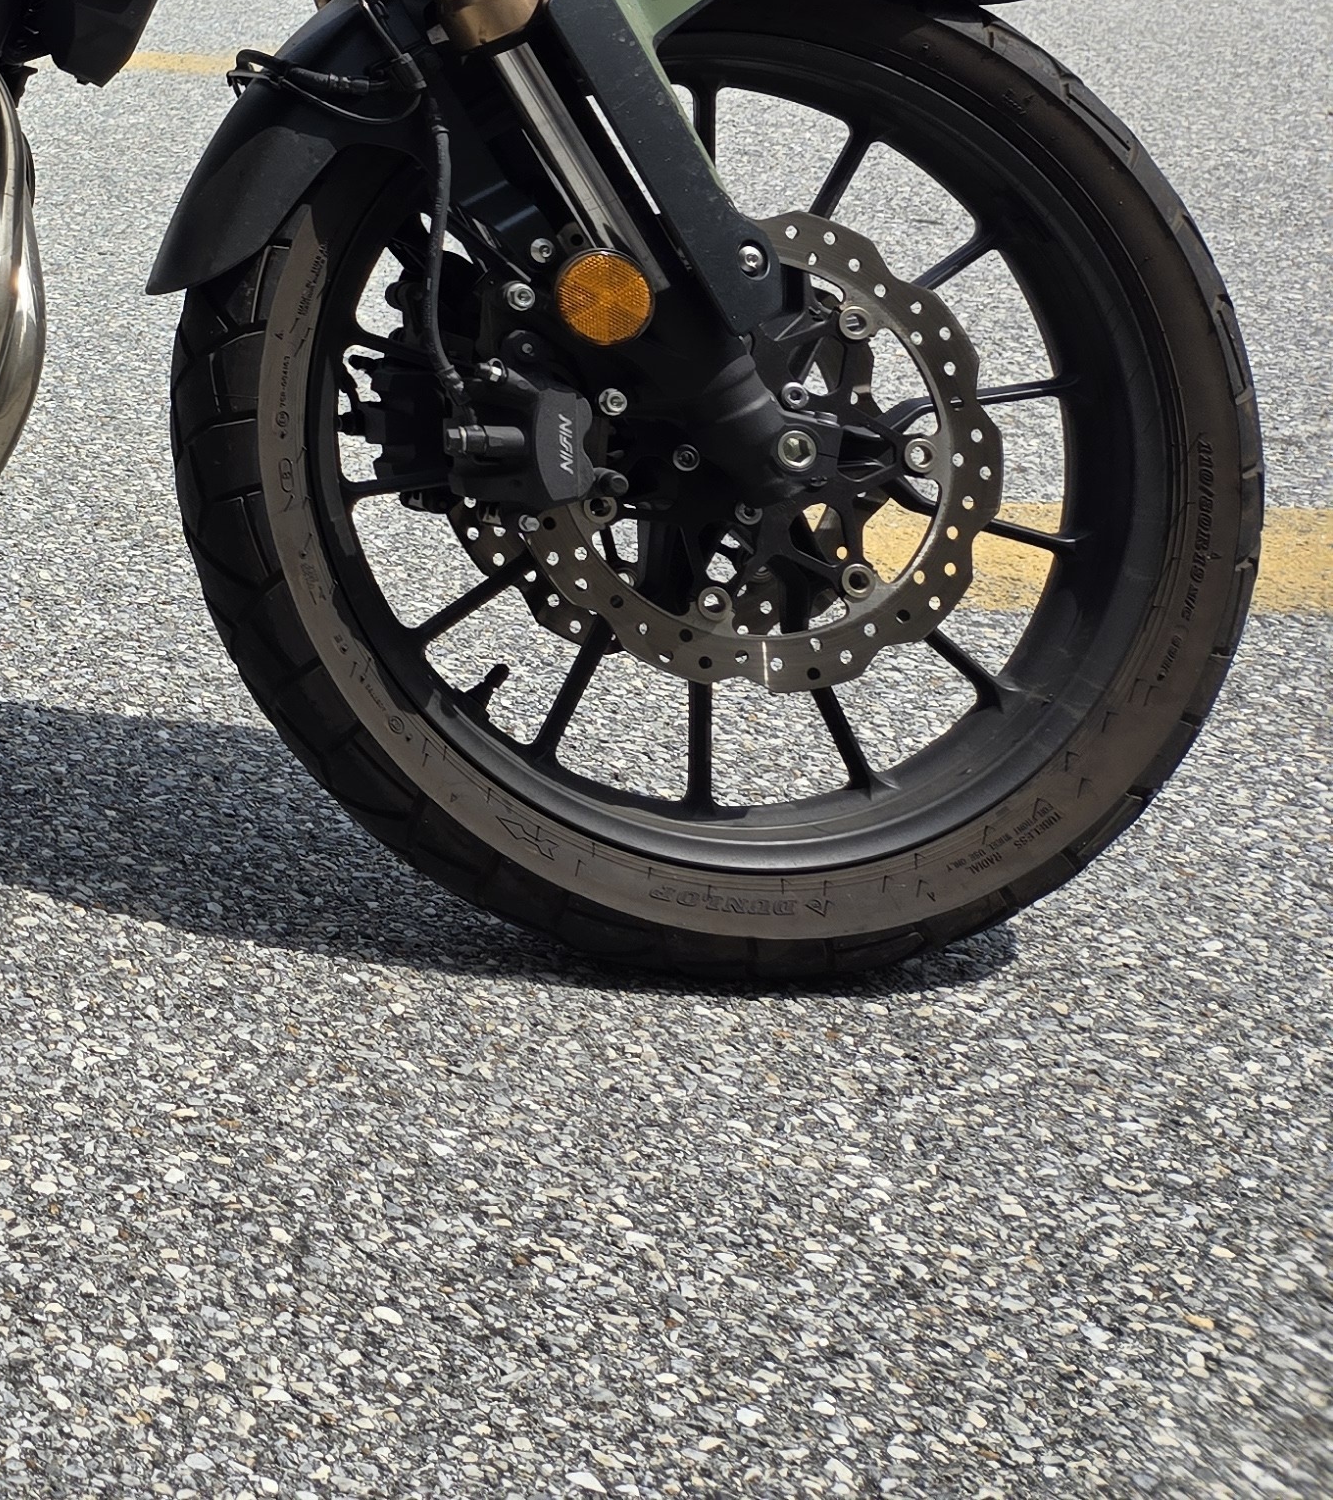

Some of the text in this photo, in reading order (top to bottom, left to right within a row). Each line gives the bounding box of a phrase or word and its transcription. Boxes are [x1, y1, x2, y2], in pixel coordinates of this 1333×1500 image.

[558, 413, 574, 475] NISSIN
[965, 810, 1064, 875] TUBELESS RADIAL
[648, 885, 798, 916] DUNLOP
